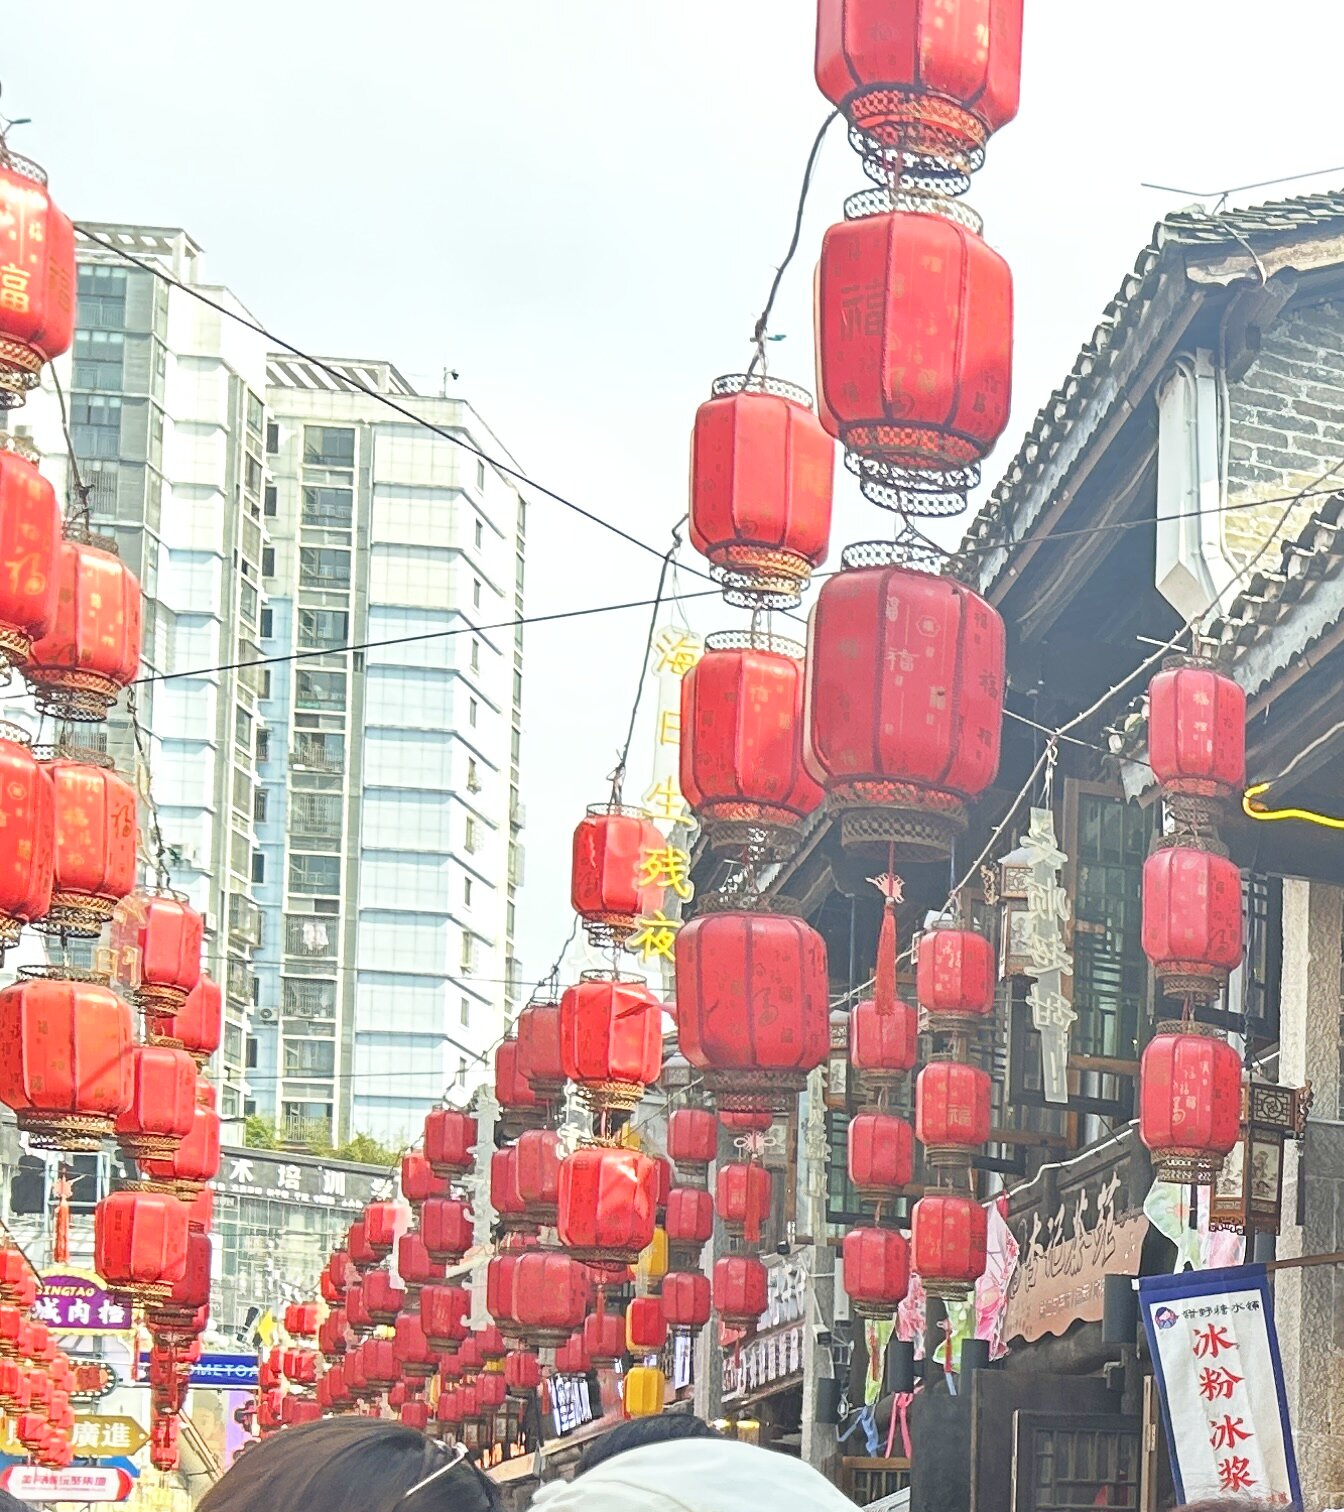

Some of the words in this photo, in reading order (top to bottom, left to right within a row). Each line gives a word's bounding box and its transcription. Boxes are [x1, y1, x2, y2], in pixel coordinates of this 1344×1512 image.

[632, 632, 702, 964] 海日生残夜
[1192, 1323, 1257, 1493] 冰粉冰浆
